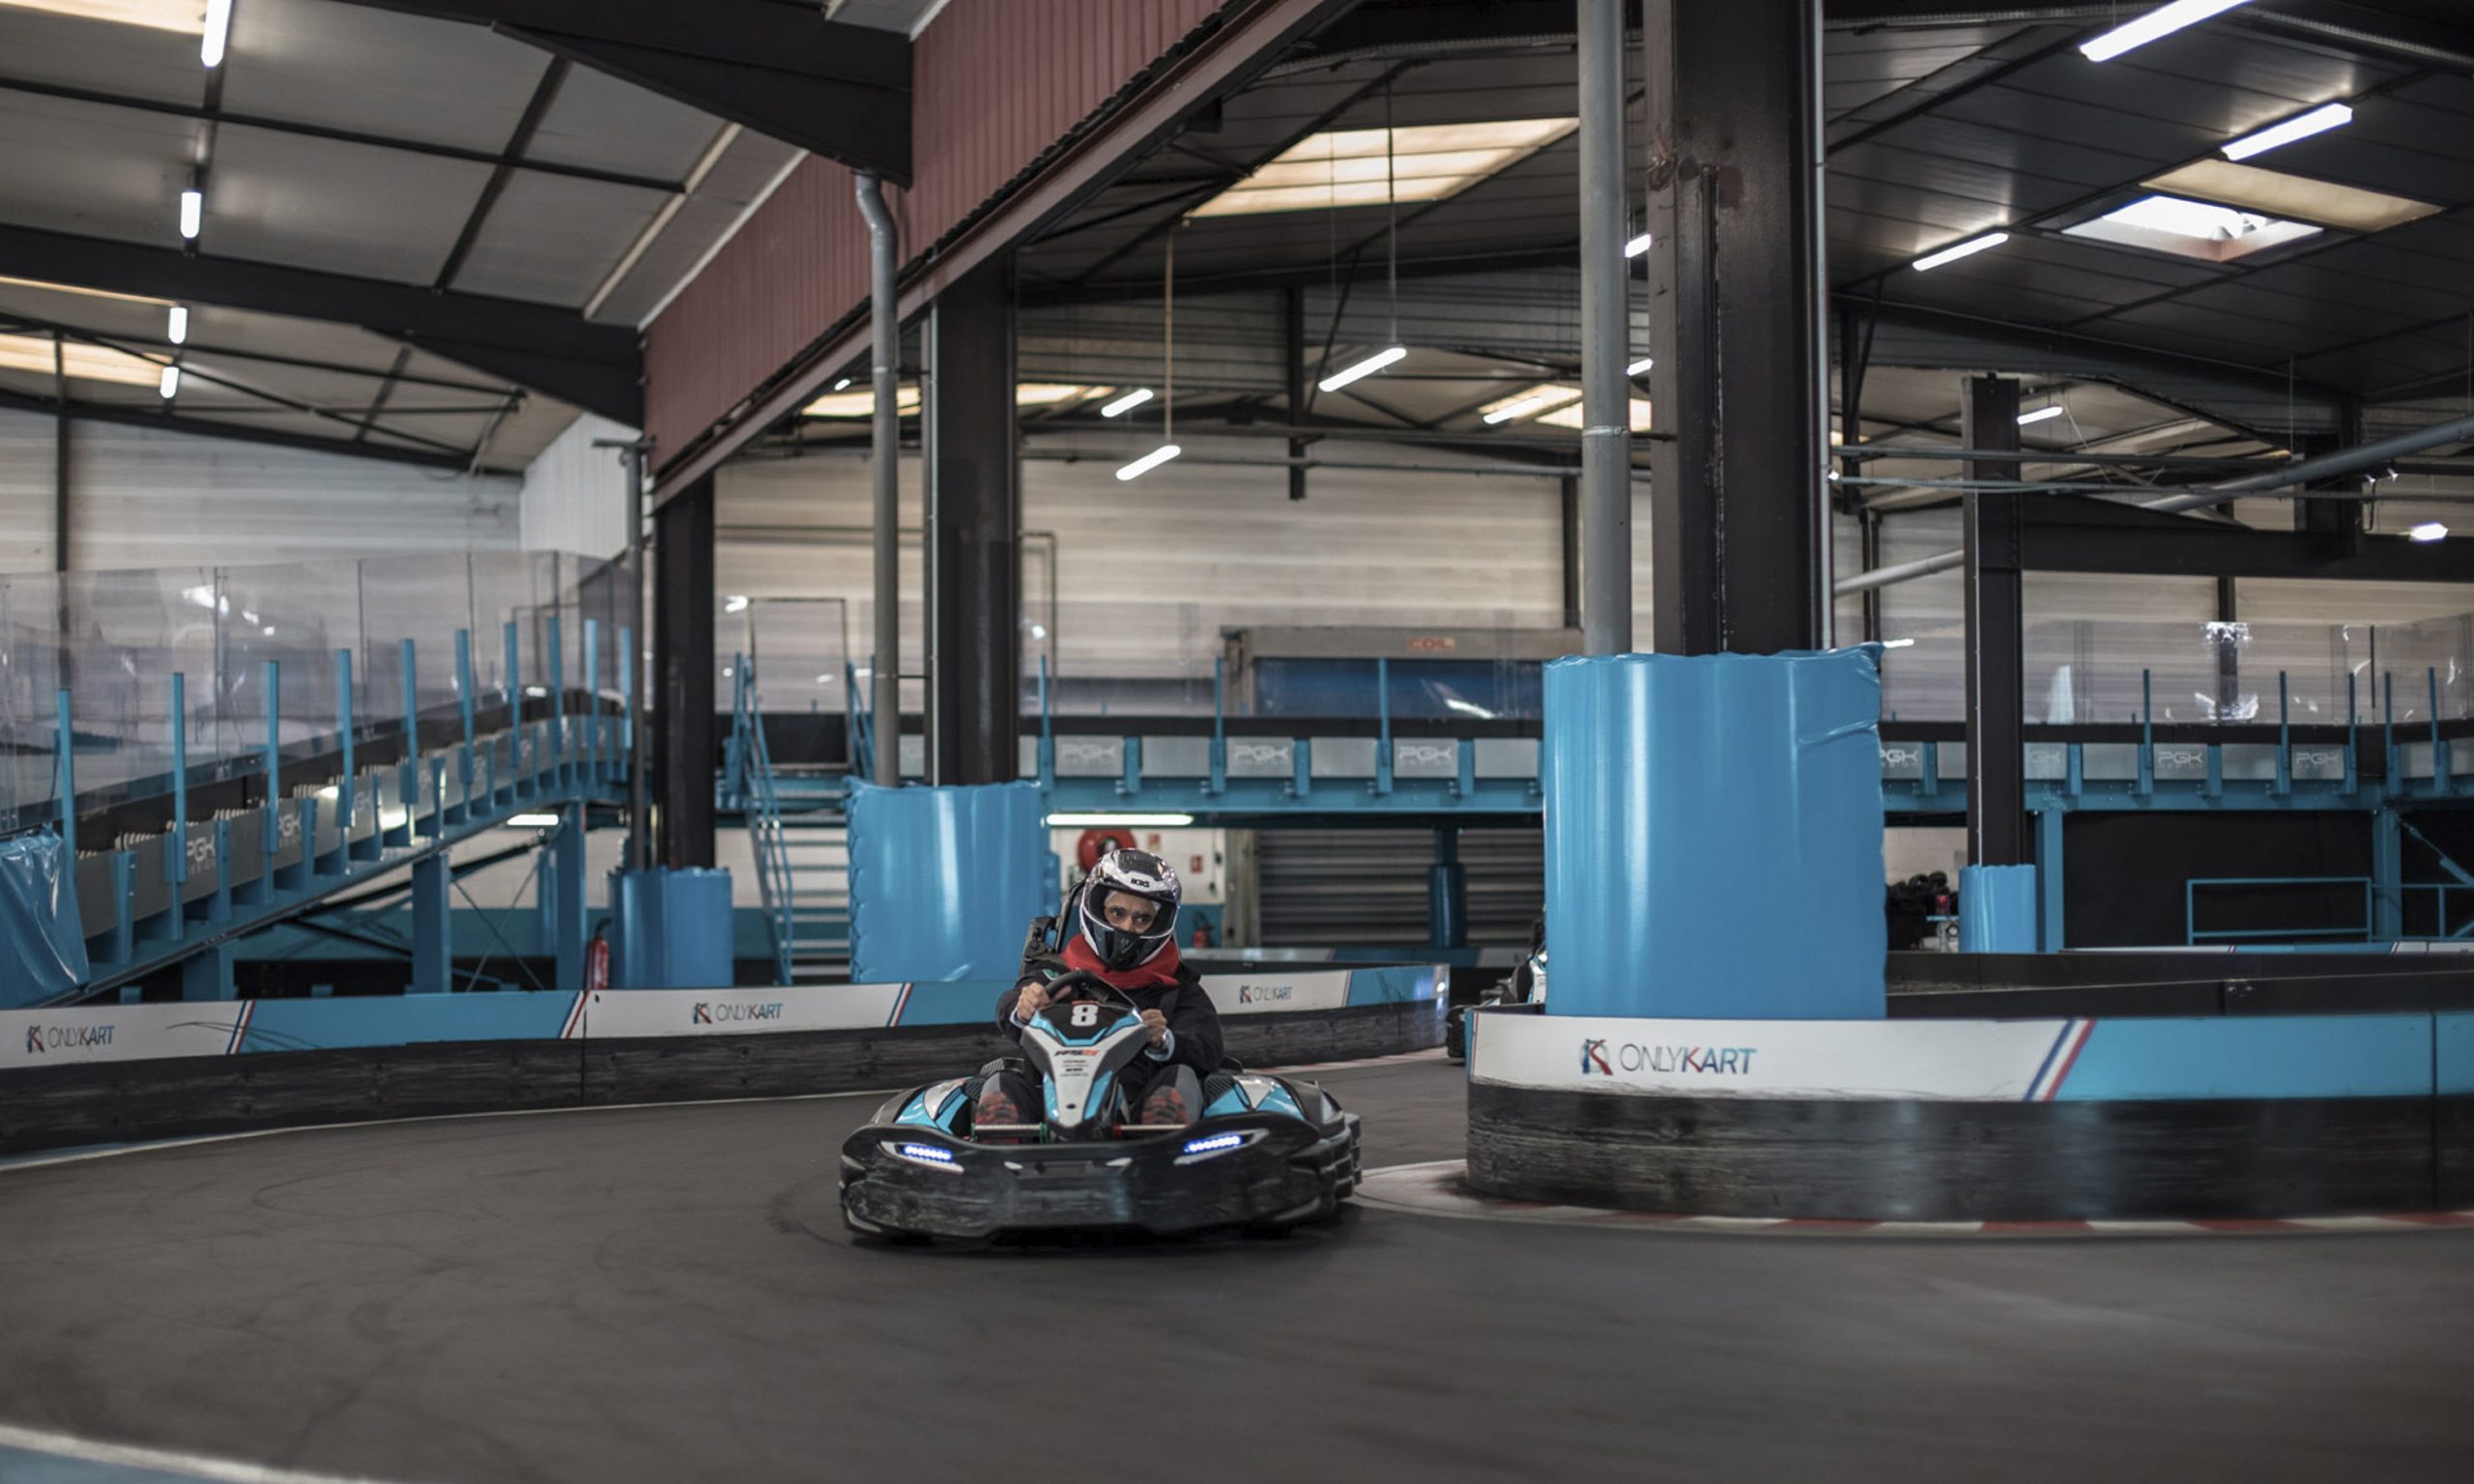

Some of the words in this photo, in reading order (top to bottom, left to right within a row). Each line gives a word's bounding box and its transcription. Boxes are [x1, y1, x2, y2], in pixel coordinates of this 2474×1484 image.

[2157, 751, 2203, 764] PGK
[2296, 753, 2339, 764] PGK
[716, 1003, 784, 1021] ONLYKART
[1071, 1004, 1099, 1027] 8
[47, 1025, 115, 1048] ONLYKART
[1620, 1042, 1758, 1074] ONLYKART
